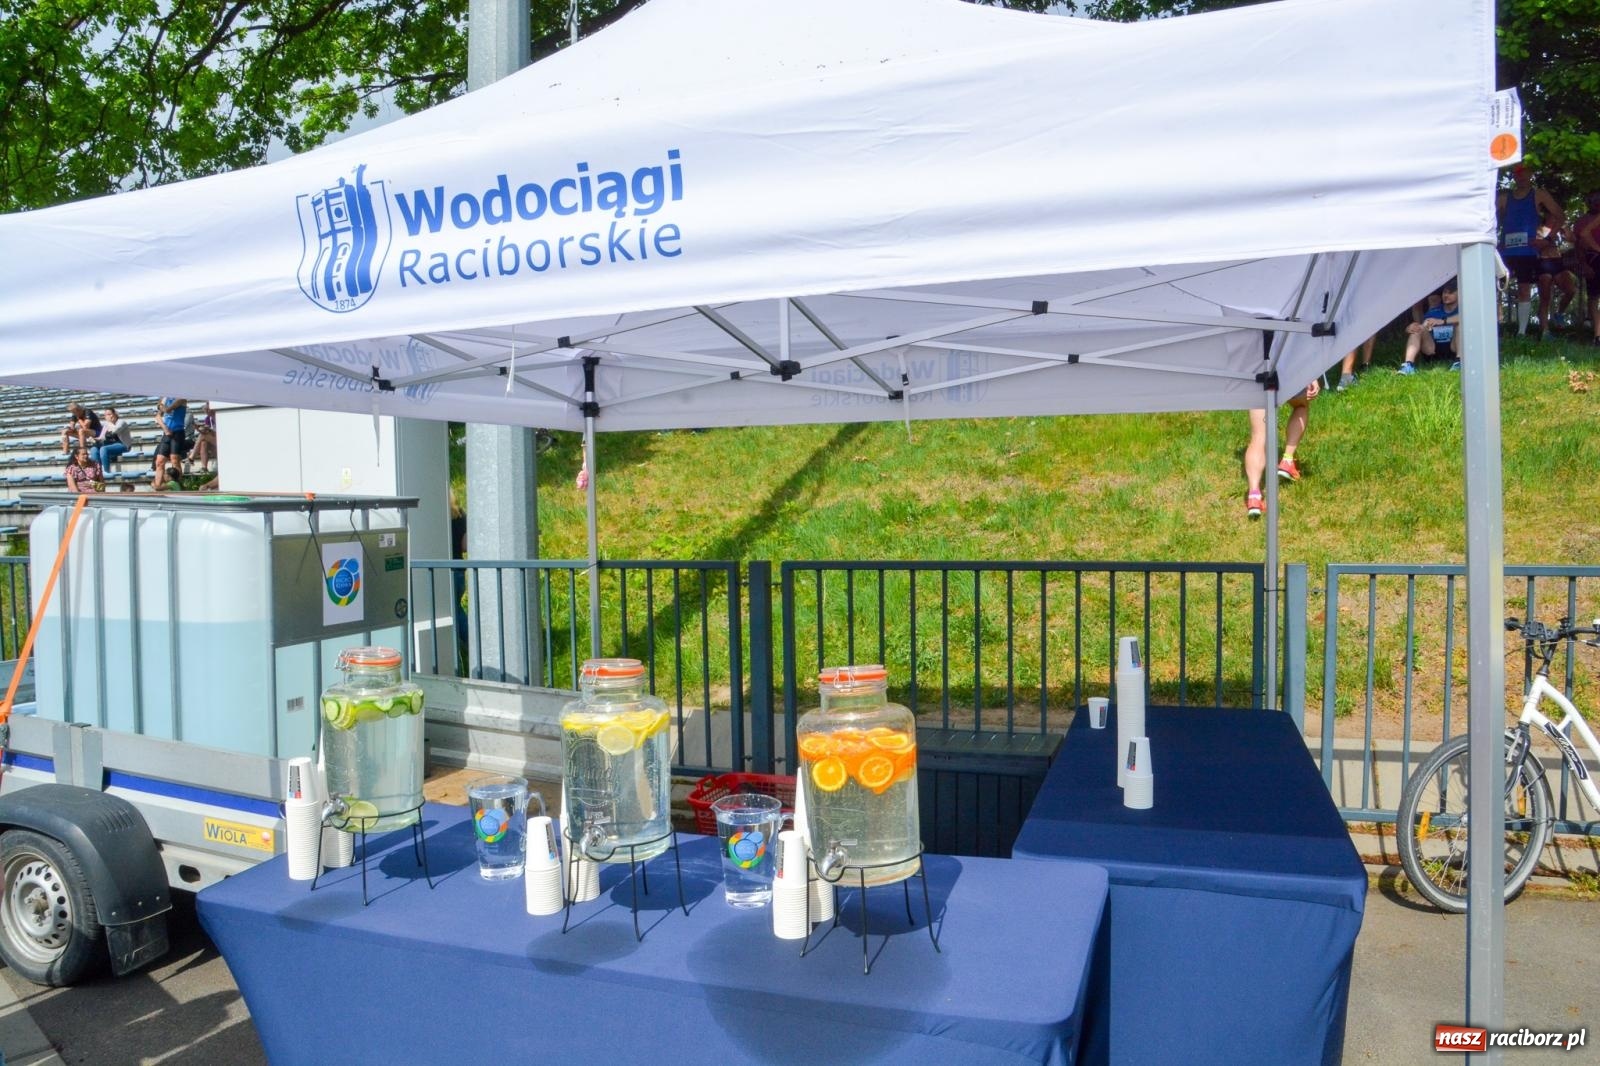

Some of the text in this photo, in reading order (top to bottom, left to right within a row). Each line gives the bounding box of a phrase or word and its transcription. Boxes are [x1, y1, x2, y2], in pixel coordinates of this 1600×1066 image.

[394, 149, 683, 236] Wodociągi
[401, 219, 683, 288] Raciborskie
[335, 298, 356, 310] 1874
